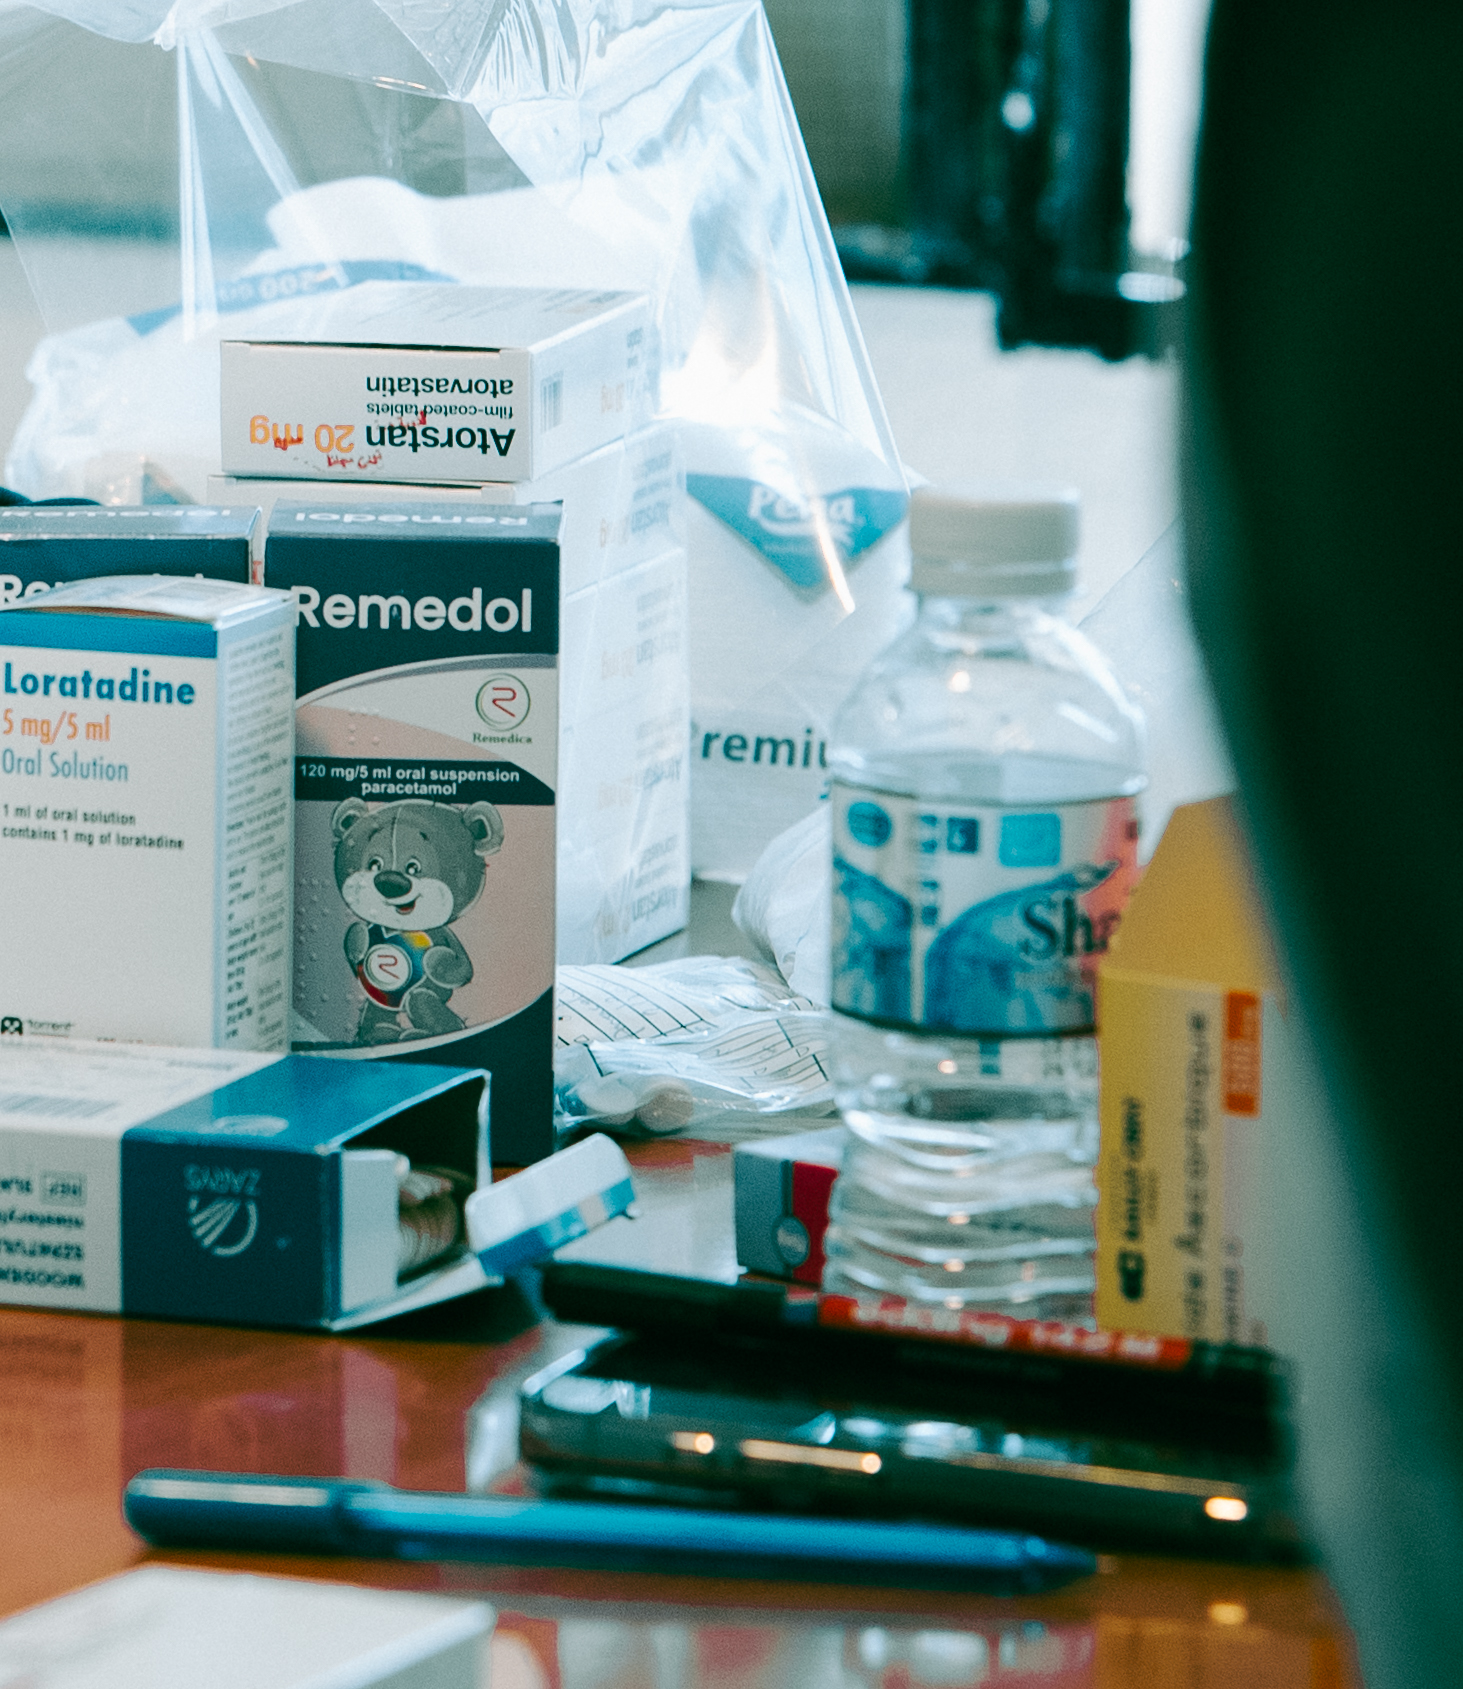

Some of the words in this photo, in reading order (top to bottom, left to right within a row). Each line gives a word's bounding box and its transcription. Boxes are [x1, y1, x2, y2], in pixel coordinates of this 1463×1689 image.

[365, 376, 514, 398] atorvastatin
[365, 402, 419, 418] tablets
[422, 403, 514, 419] film-coated
[249, 415, 305, 450] mg
[314, 423, 355, 453] 20
[365, 425, 516, 457] Atorstan
[291, 585, 532, 633] Remedol
[3, 662, 196, 706] Loratadine
[2, 708, 15, 735] 5
[21, 710, 79, 746] mg/5
[85, 714, 112, 742] ml
[472, 732, 533, 745] Remedica
[691, 719, 830, 770] remi
[1, 748, 43, 776] Oral
[50, 751, 130, 782] Solution
[300, 764, 327, 778] 120
[330, 765, 369, 781] mg/5
[373, 766, 392, 780] ml
[396, 767, 426, 780] oral
[430, 768, 520, 783] suspension
[361, 781, 458, 795] paracetamol
[3, 804, 10, 818] 1
[15, 805, 32, 819] ml
[36, 805, 48, 820] of
[52, 807, 78, 822] oral
[83, 809, 136, 826] solution
[2, 825, 58, 841] contains
[62, 828, 69, 842] 1
[74, 831, 94, 847] mg
[100, 830, 112, 845] of
[116, 832, 185, 850] loratadine
